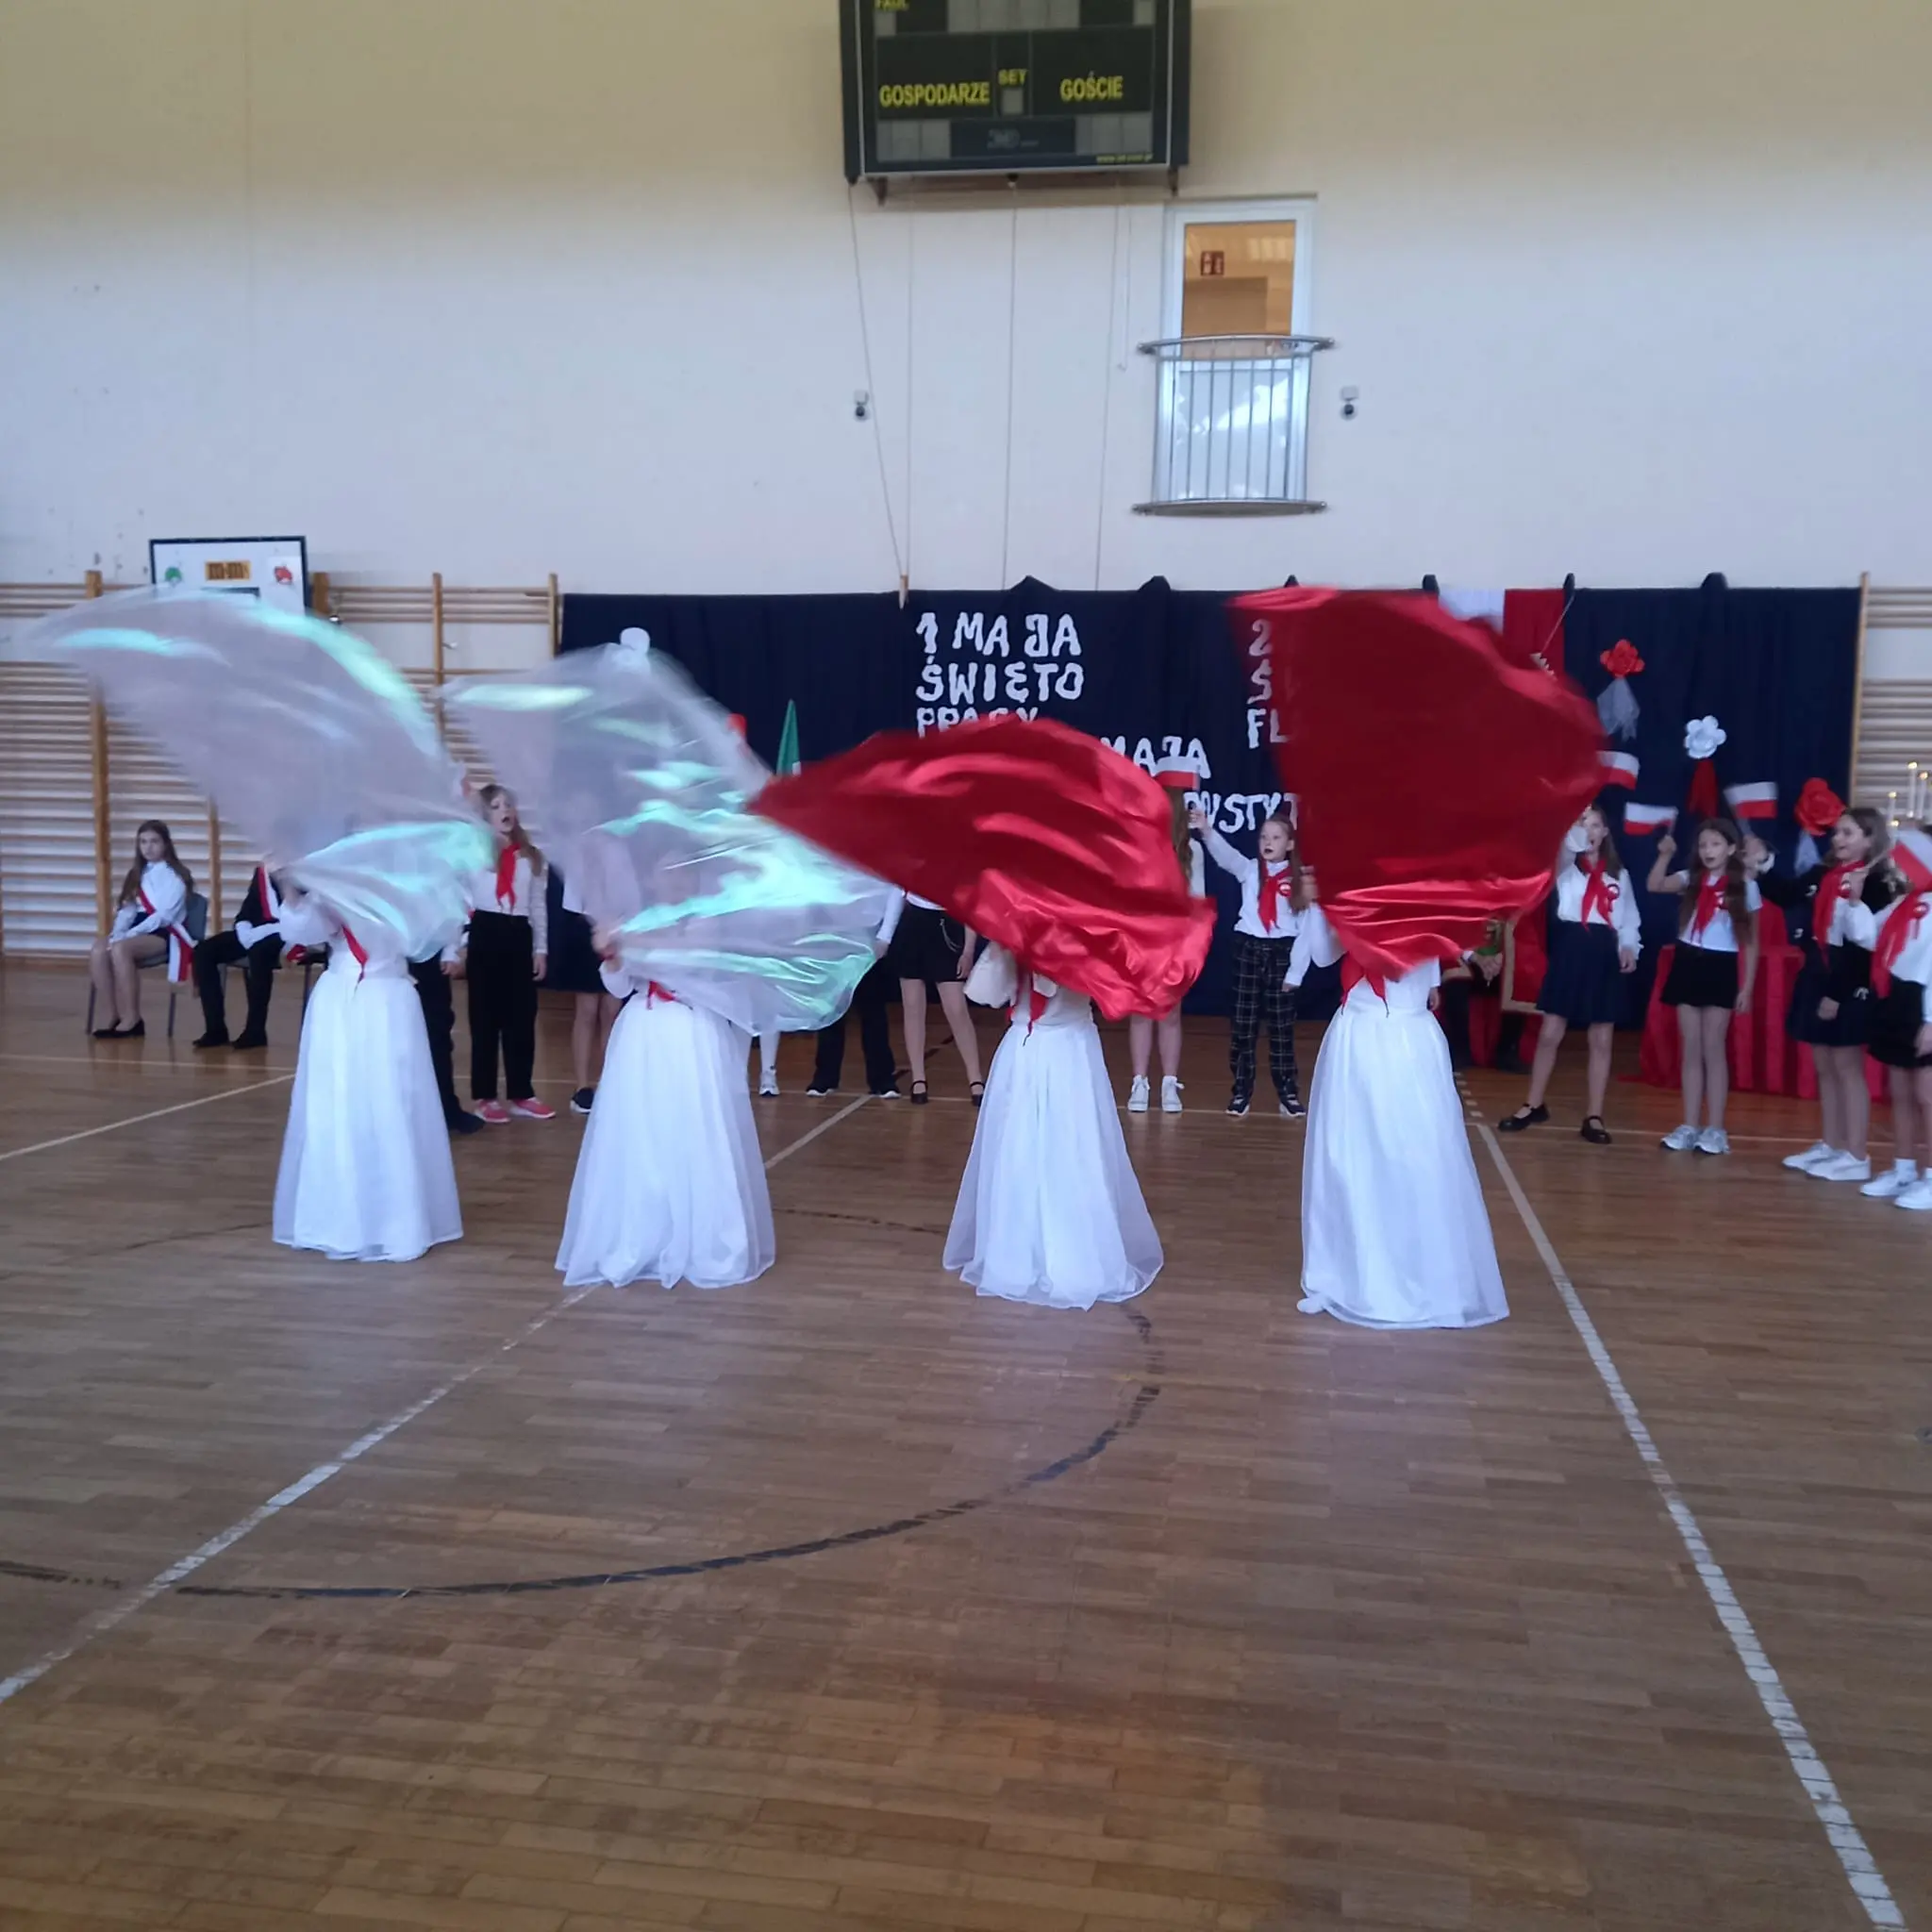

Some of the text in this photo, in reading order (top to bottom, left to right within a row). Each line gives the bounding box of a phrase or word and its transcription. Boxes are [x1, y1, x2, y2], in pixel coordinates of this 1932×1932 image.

[879, 81, 991, 108] GOSPODARZE
[1059, 72, 1124, 101] GOŚCIE
[915, 612, 939, 655] 1
[1248, 619, 1274, 657] 2
[915, 656, 1085, 705] ŚWIĘTO
